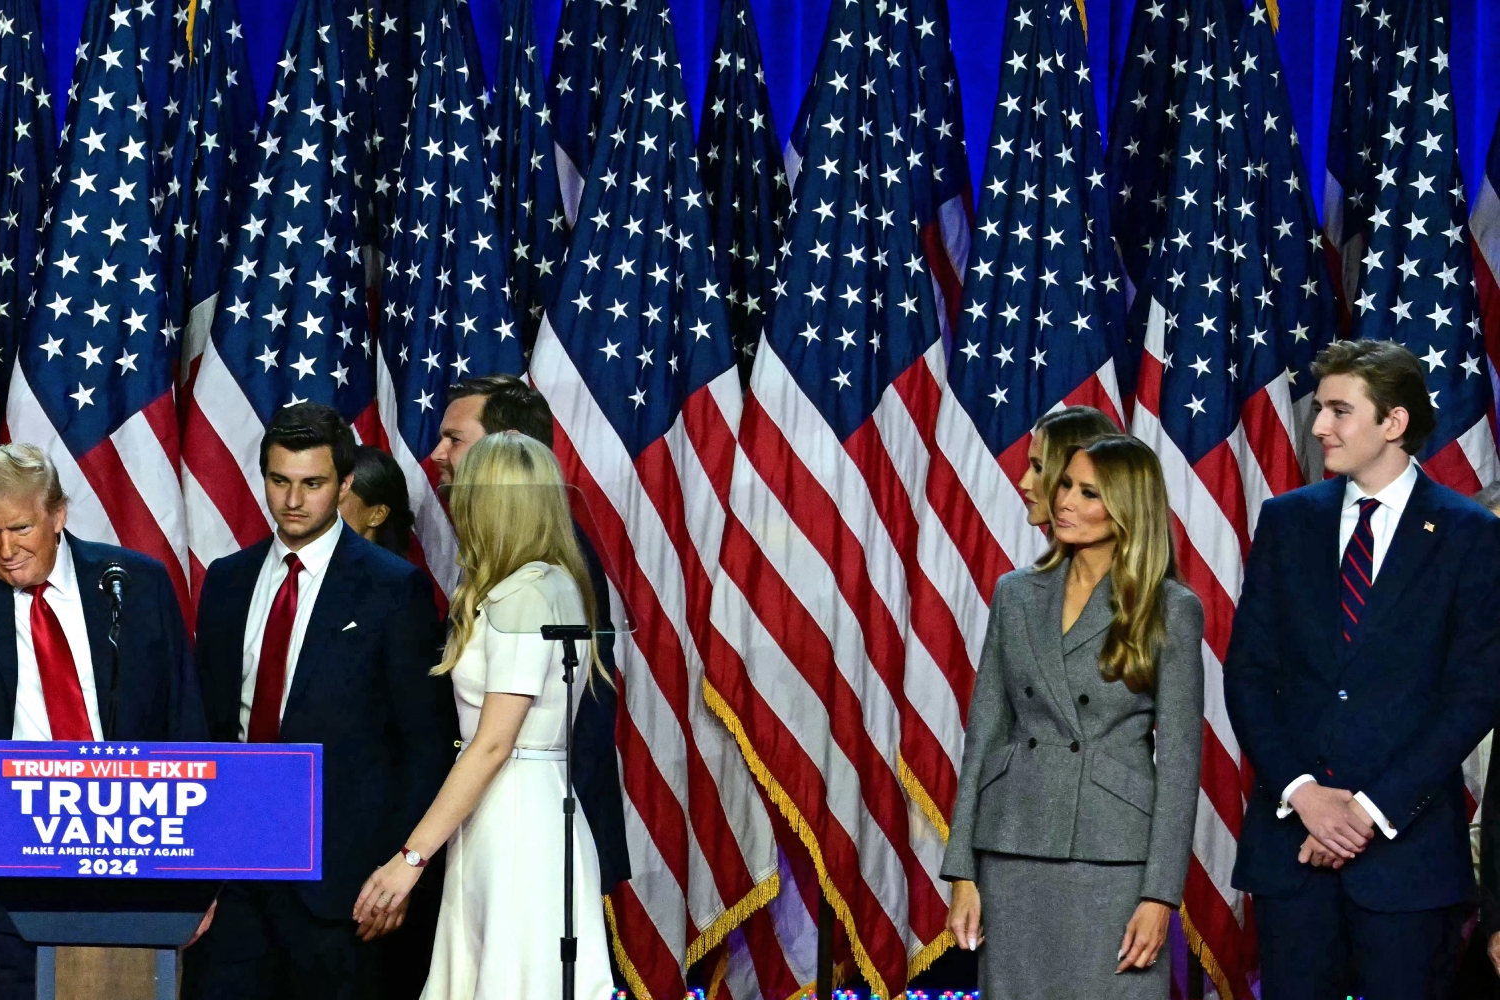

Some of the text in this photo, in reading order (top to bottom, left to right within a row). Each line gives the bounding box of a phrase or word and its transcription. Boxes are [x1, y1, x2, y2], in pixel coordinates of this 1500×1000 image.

[11, 760, 208, 778] TRUMP WILL FIX IT
[11, 781, 207, 816] TRUMP
[32, 816, 184, 845] VANCE
[22, 847, 195, 857] MAKE AMERICA GREAT AGAIN!
[78, 859, 139, 875] 2024
